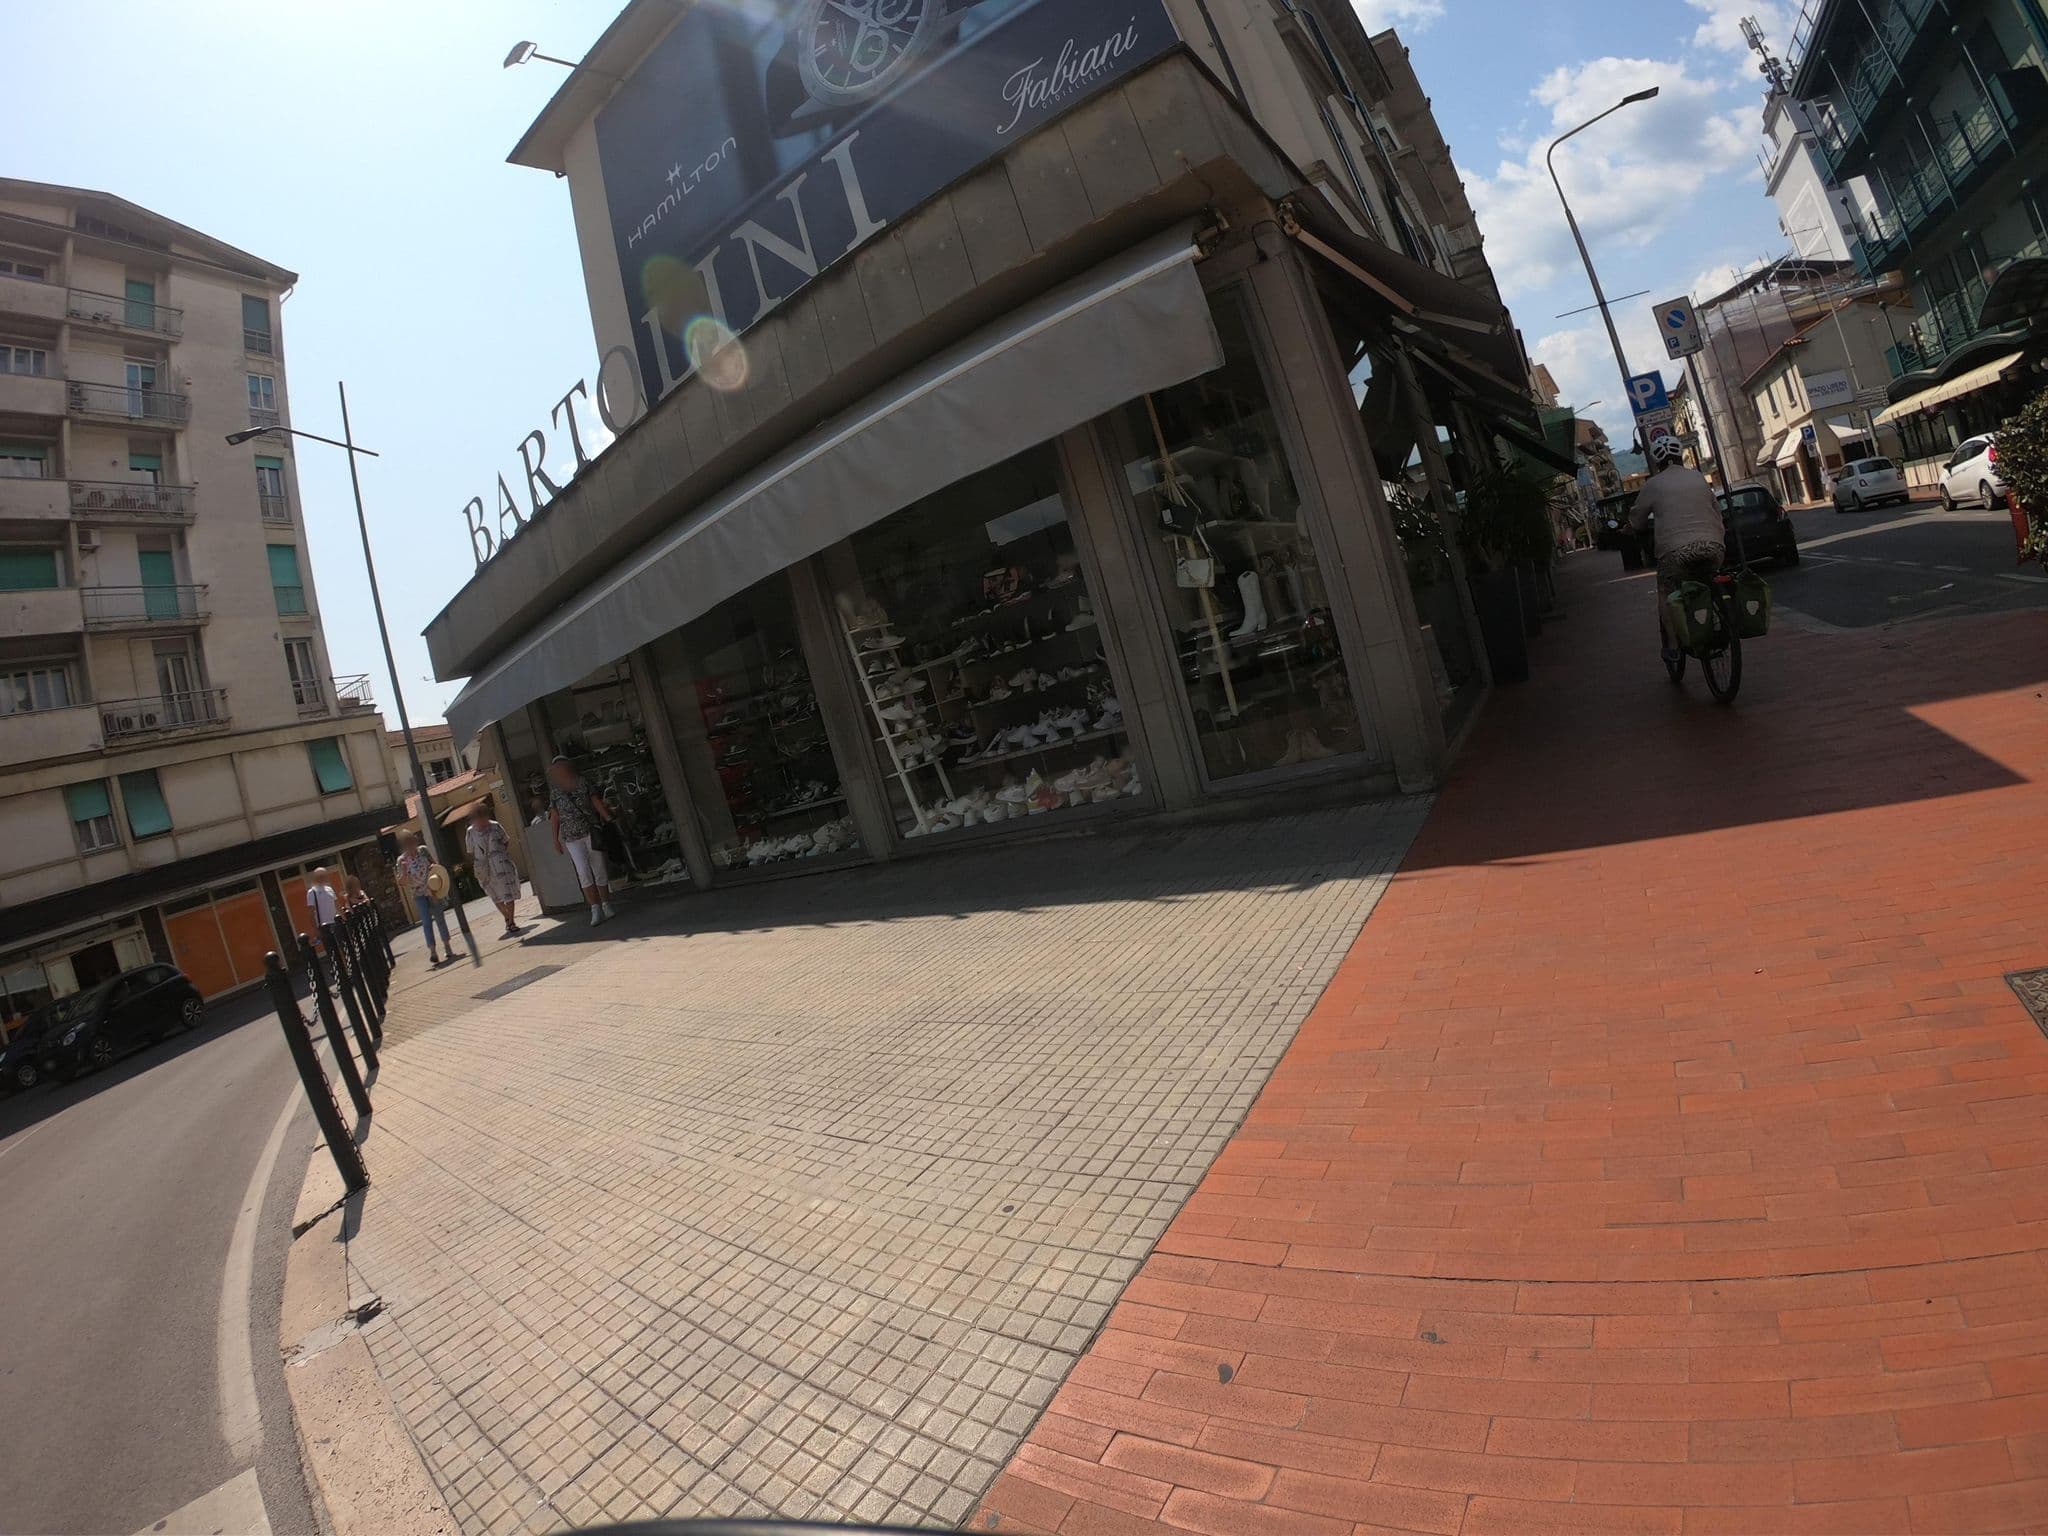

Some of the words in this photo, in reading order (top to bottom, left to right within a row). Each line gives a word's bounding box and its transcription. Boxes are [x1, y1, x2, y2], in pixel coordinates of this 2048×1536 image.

[997, 16, 1138, 134] Fabiani
[627, 137, 737, 249] HAMILTON
[462, 129, 887, 576] BARTOLINI
[1632, 378, 1656, 409] P
